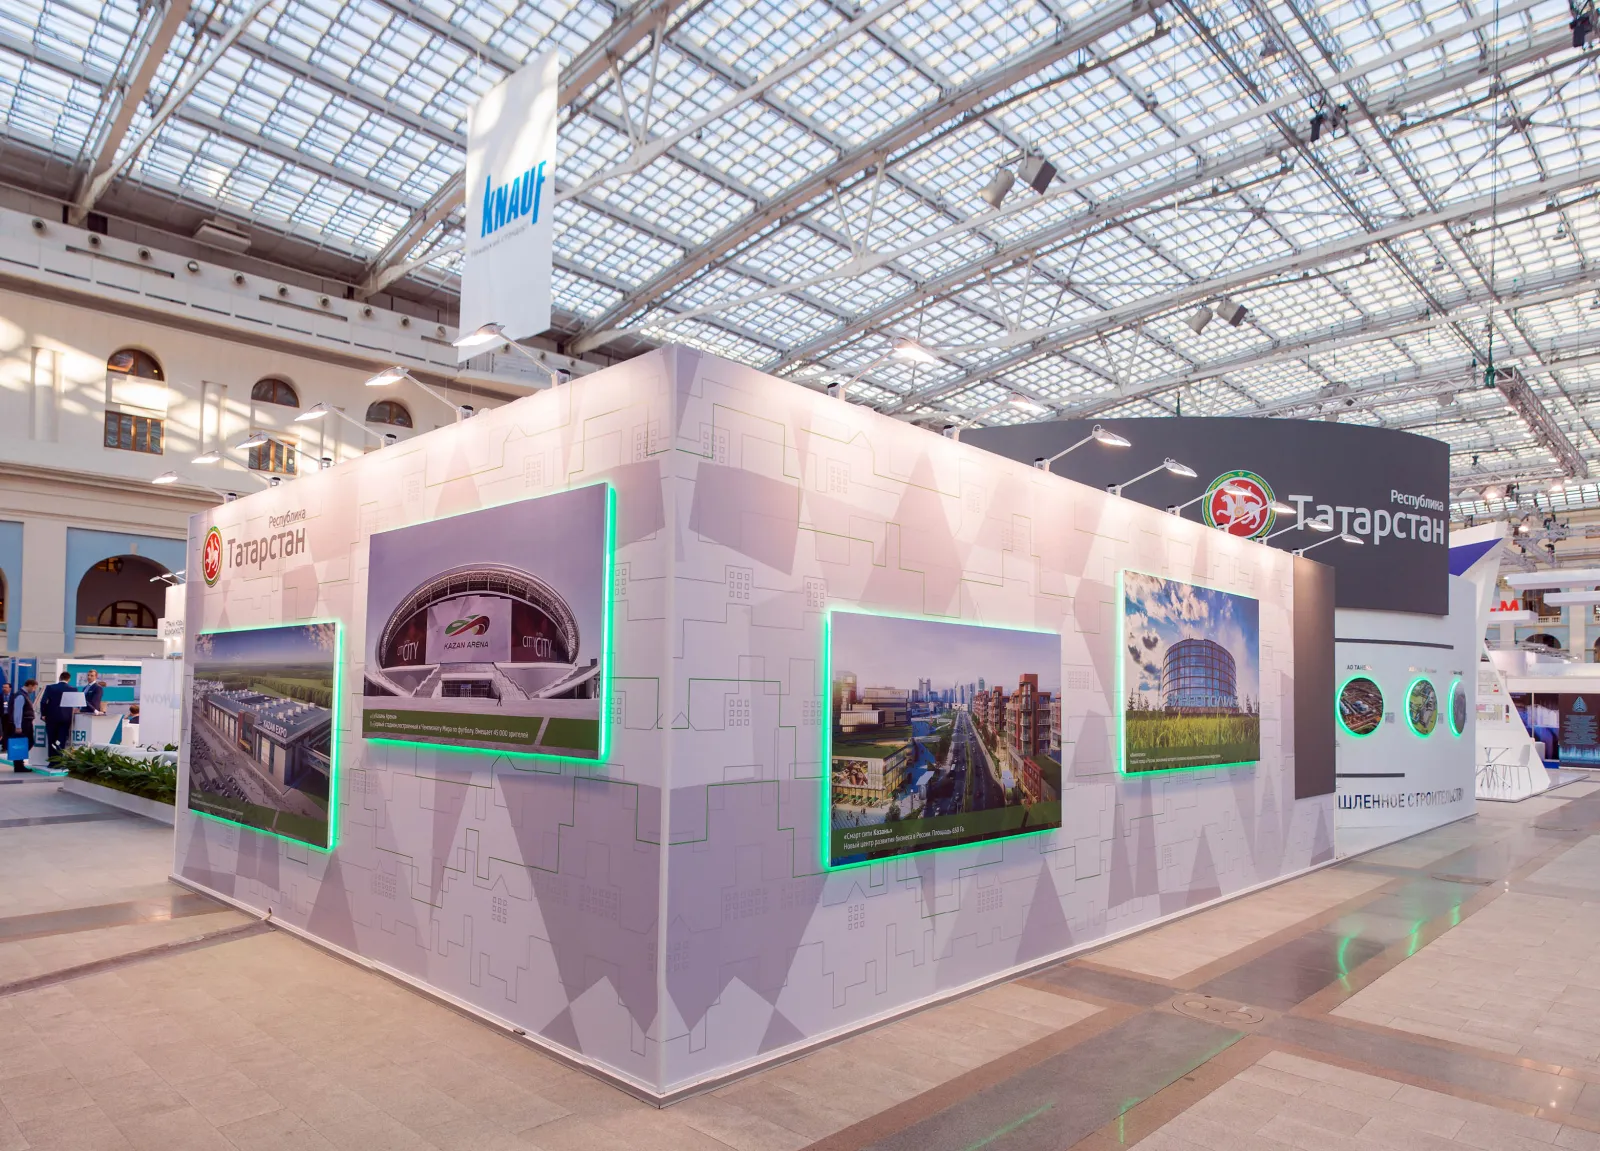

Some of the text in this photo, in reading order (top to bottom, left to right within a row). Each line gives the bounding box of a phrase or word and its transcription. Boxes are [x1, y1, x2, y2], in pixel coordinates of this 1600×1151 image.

[481, 160, 547, 238] KNAUF
[1391, 489, 1444, 511] Республика
[268, 509, 306, 528] Республика
[1288, 494, 1445, 545] Татарстан
[227, 527, 306, 570] Татарстан
[444, 641, 489, 650] KAZAN ARENA
[275, 724, 288, 738] EXPO
[1338, 793, 1405, 810] ШЛЕННОЕ
[843, 841, 860, 850] Новый
